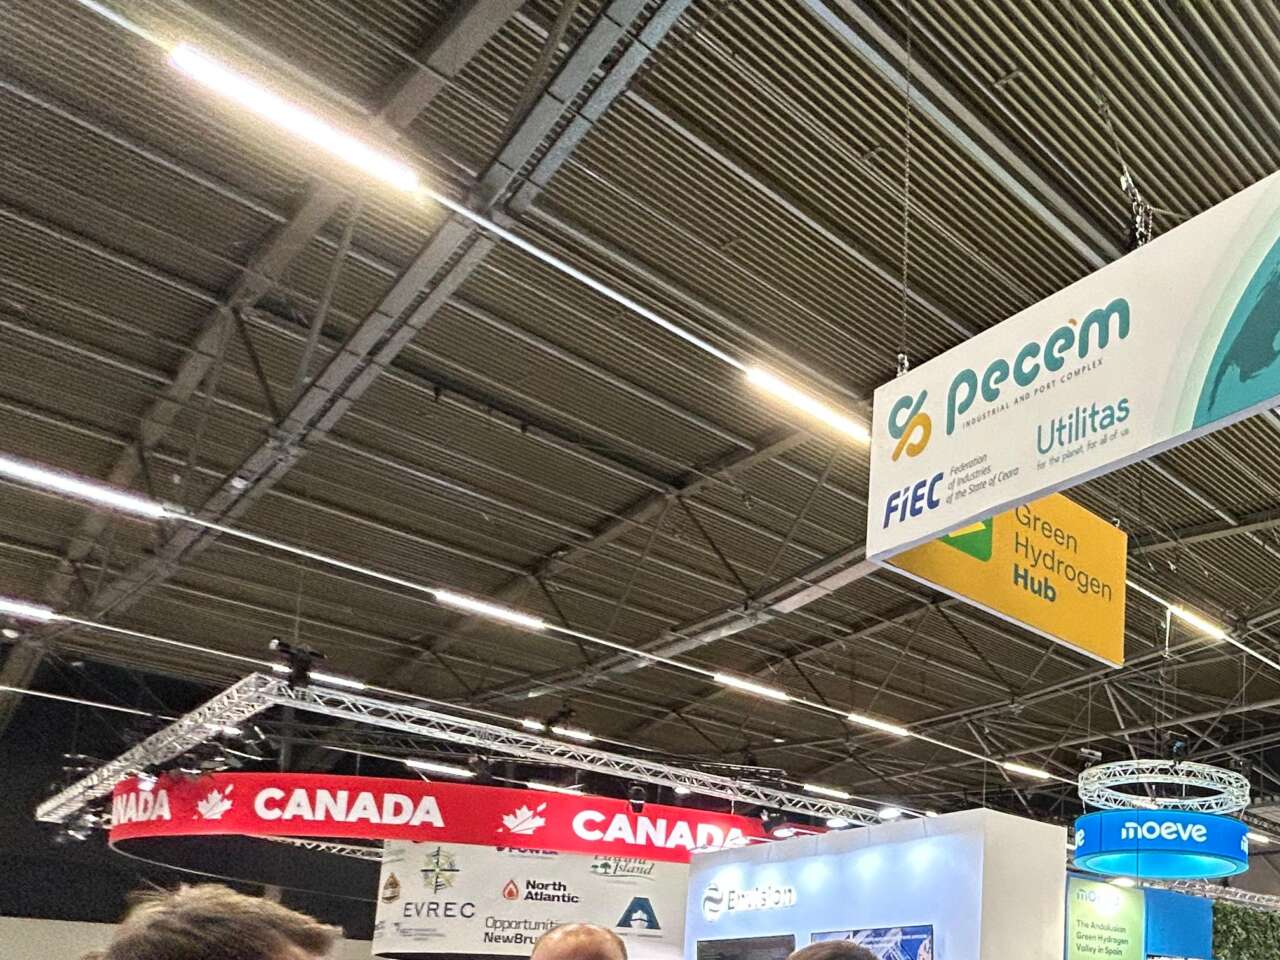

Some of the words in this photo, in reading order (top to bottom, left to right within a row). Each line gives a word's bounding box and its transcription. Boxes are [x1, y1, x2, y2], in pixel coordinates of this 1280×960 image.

[962, 403, 1010, 430] INDUSTRIAL
[1013, 393, 1031, 405] AND
[1033, 380, 1056, 396] PORT
[1060, 357, 1104, 384] COMPLEX
[1037, 397, 1130, 455] Utilitas
[950, 453, 988, 477] Federation
[947, 477, 956, 491] of
[956, 464, 991, 487] Industries
[954, 488, 968, 501] the
[968, 480, 987, 495] State
[1015, 504, 1078, 555] Green
[1015, 531, 1112, 602] Hydrogen
[1013, 563, 1057, 602] Hub
[112, 789, 171, 826] NADA
[253, 787, 445, 828] CANADA
[572, 810, 751, 851] CANADA
[1121, 821, 1208, 842] moeve
[613, 862, 656, 875] Island
[526, 880, 567, 891] North
[524, 890, 580, 903] Atlantic
[403, 902, 476, 918] EVREC
[485, 916, 556, 932] Opportunit
[1076, 919, 1089, 929] The
[484, 932, 537, 945] NewBru
[1076, 931, 1096, 940] Green
[1098, 934, 1129, 946] Hydrogen
[1076, 943, 1096, 955] Valley
[1105, 946, 1123, 957] Spain
